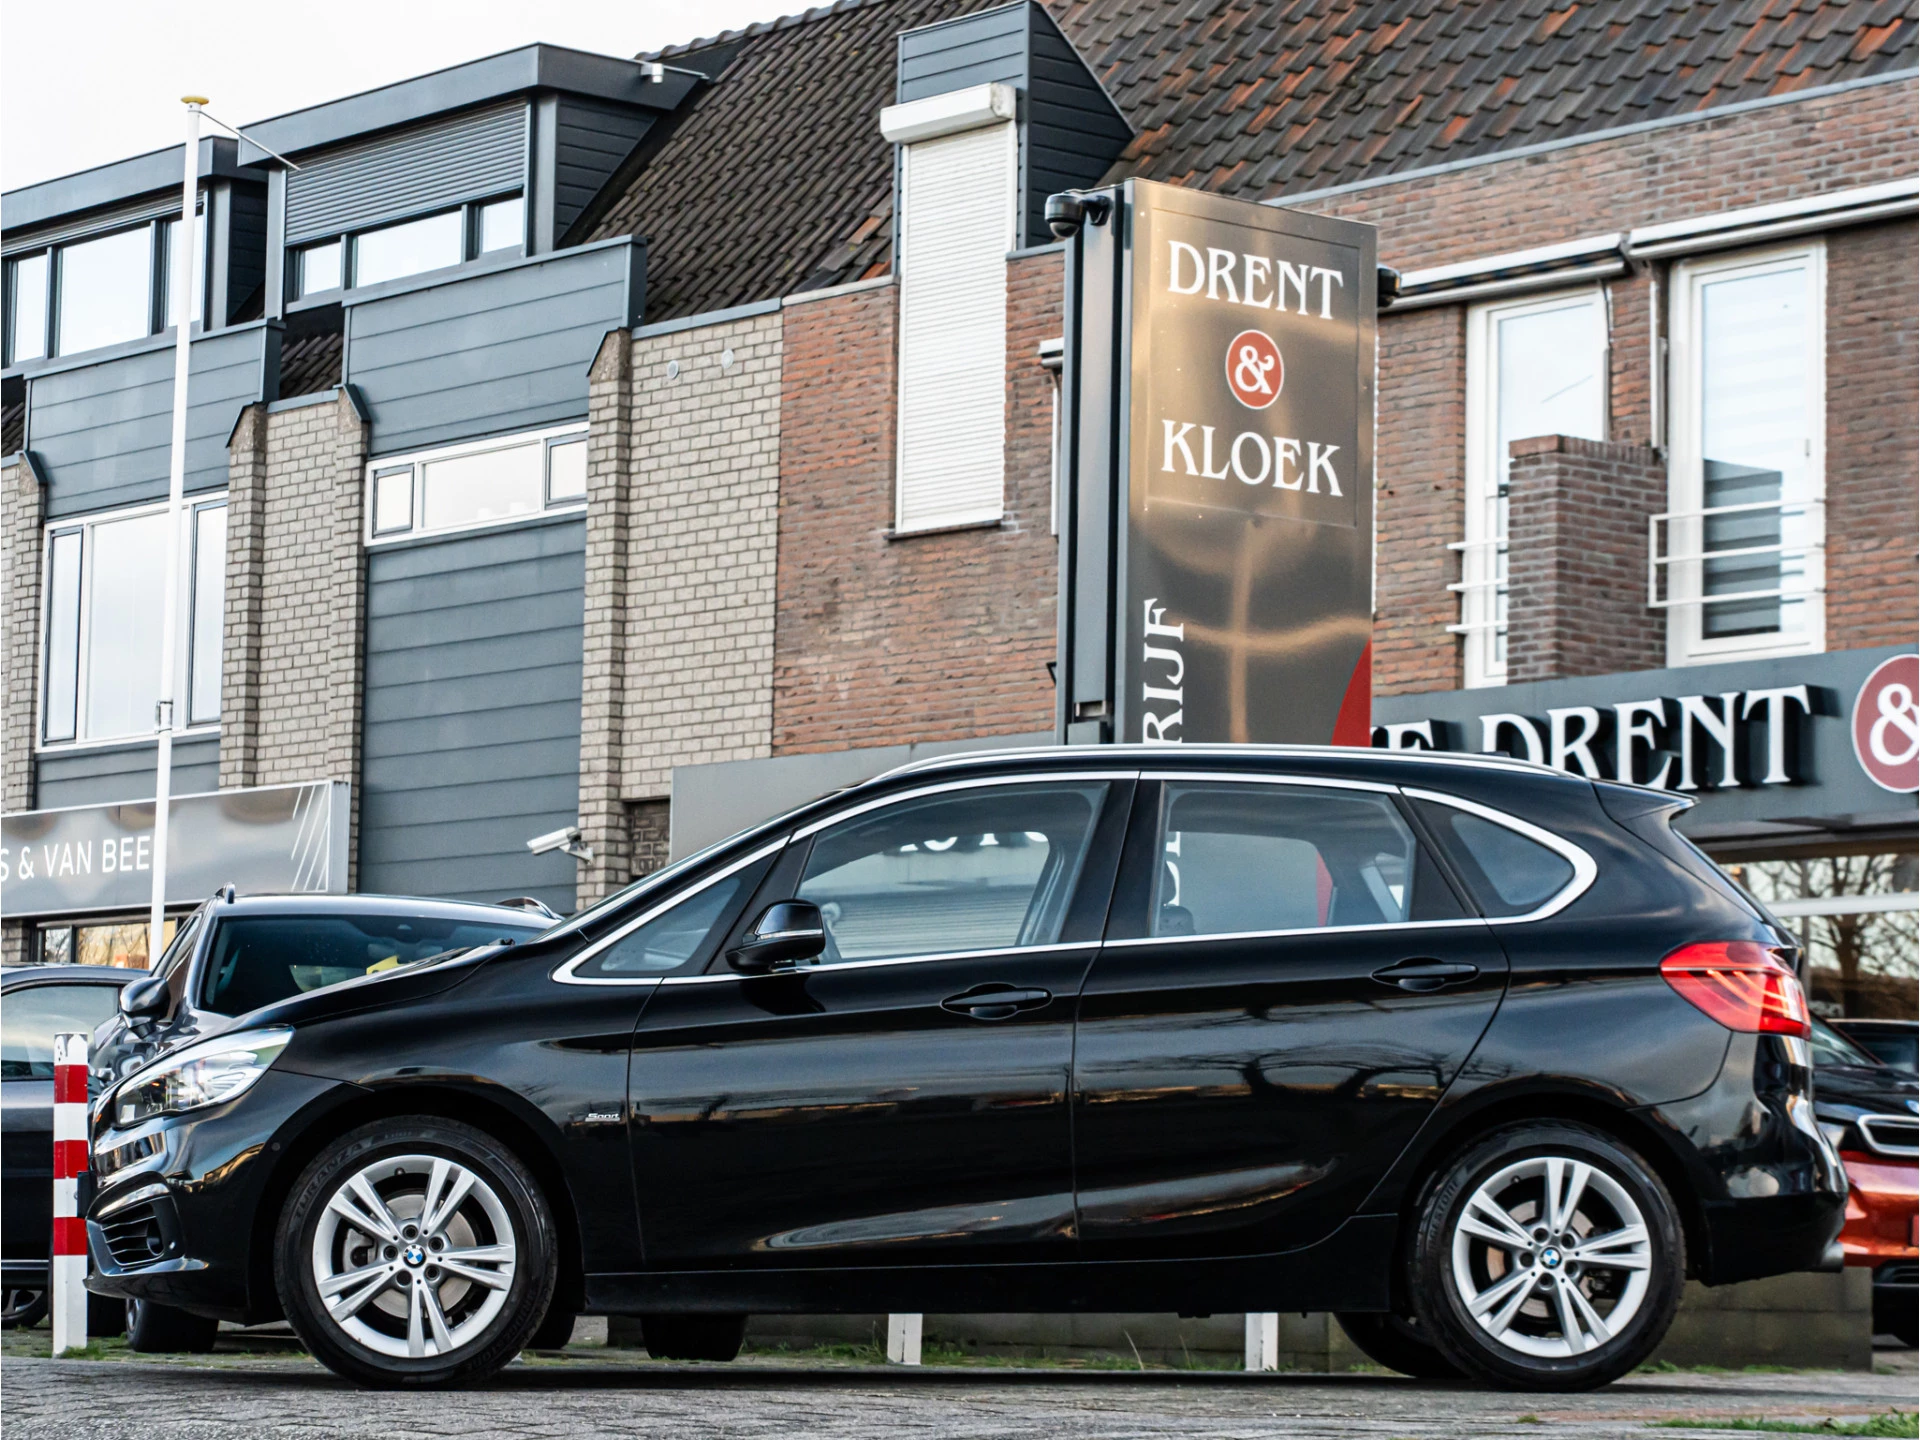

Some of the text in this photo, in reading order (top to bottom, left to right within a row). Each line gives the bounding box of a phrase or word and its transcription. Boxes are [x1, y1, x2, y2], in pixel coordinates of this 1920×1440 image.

[1168, 240, 1344, 319] DRENT
[1235, 345, 1275, 395] &
[1161, 419, 1343, 497] KLOEK
[18, 846, 35, 880] &
[44, 840, 92, 876] VAN
